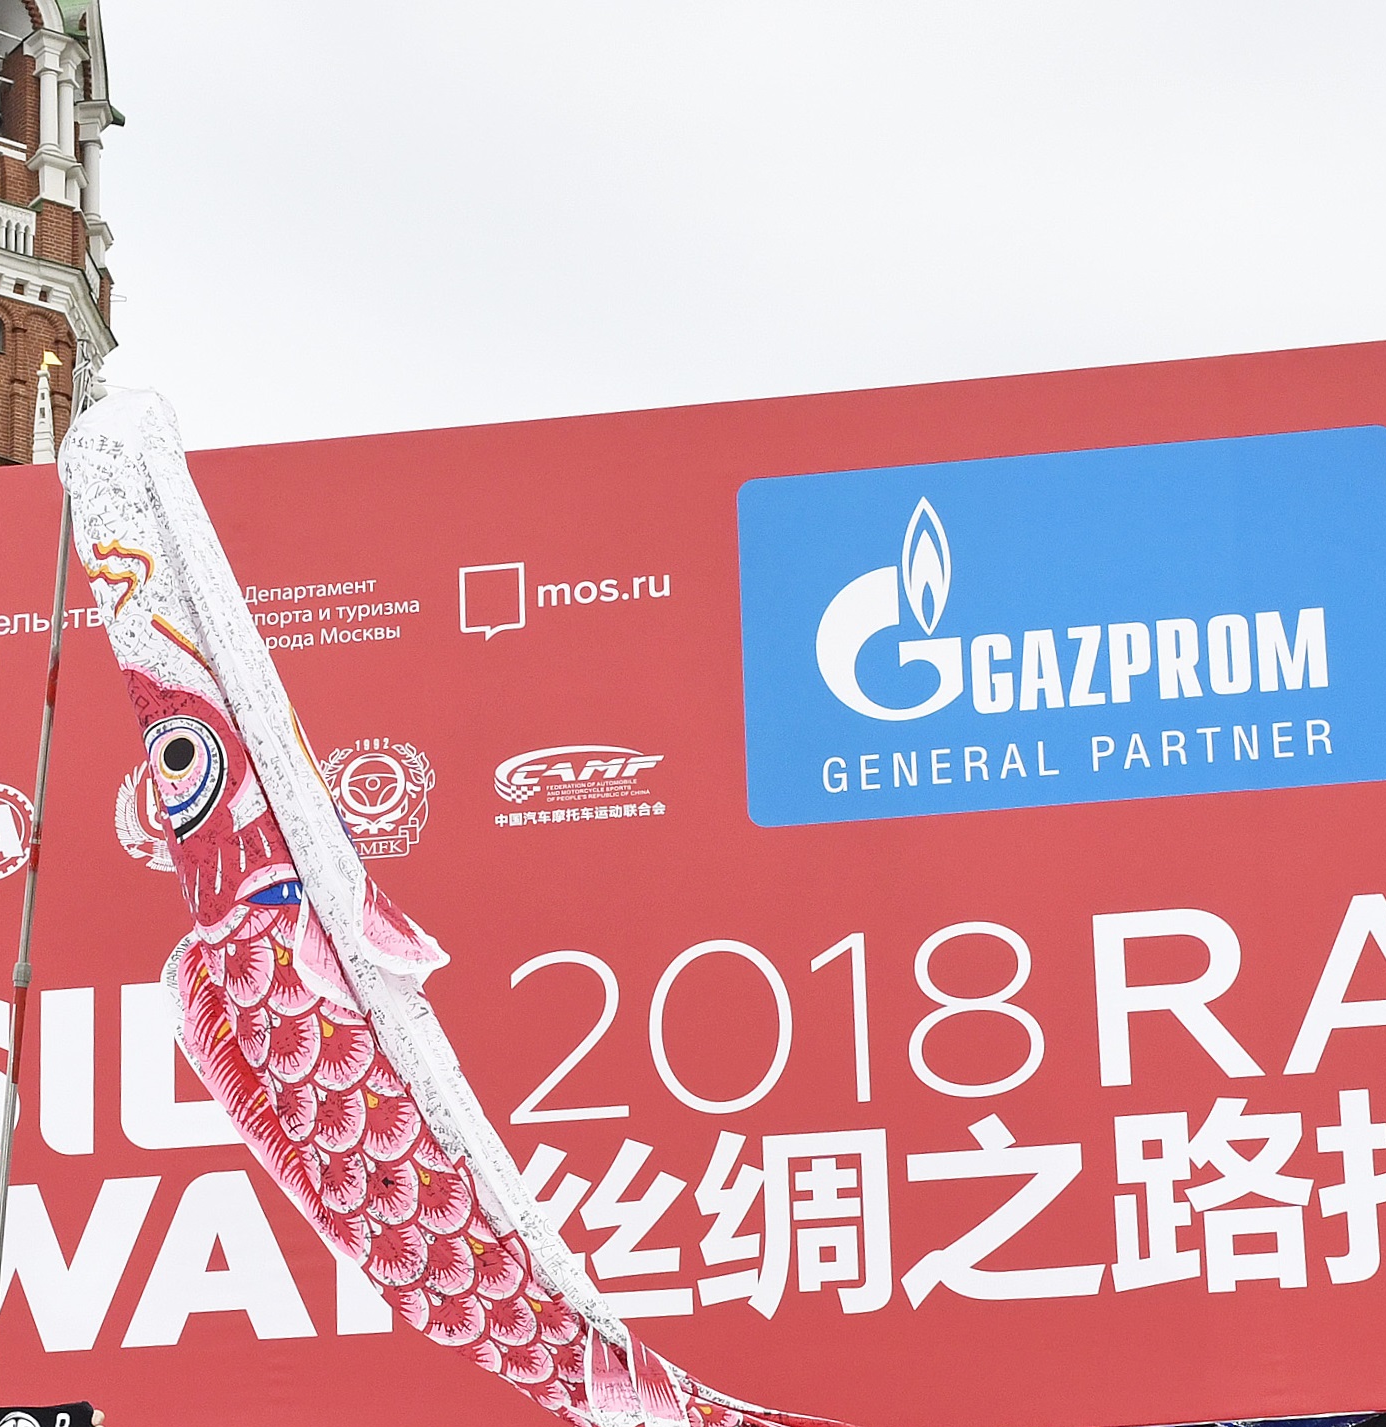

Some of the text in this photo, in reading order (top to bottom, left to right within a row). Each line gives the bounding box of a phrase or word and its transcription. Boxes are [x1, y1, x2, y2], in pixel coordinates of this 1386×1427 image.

[243, 578, 377, 606] Департамент
[536, 573, 671, 608] mos.ru
[250, 599, 420, 628] порта и туризма
[265, 624, 401, 651] рода Москвы
[971, 606, 1328, 715] GAZPROM
[354, 737, 390, 752] 1992
[822, 719, 1333, 794] GENERAL PARTNER
[545, 782, 586, 791] FEDERATION
[596, 778, 638, 787] AUTOMOBILE
[560, 787, 605, 796] MOTORCYCLE
[587, 792, 620, 800] REPUBLIC
[356, 838, 404, 856] MFK
[509, 919, 1046, 1125] 2018
